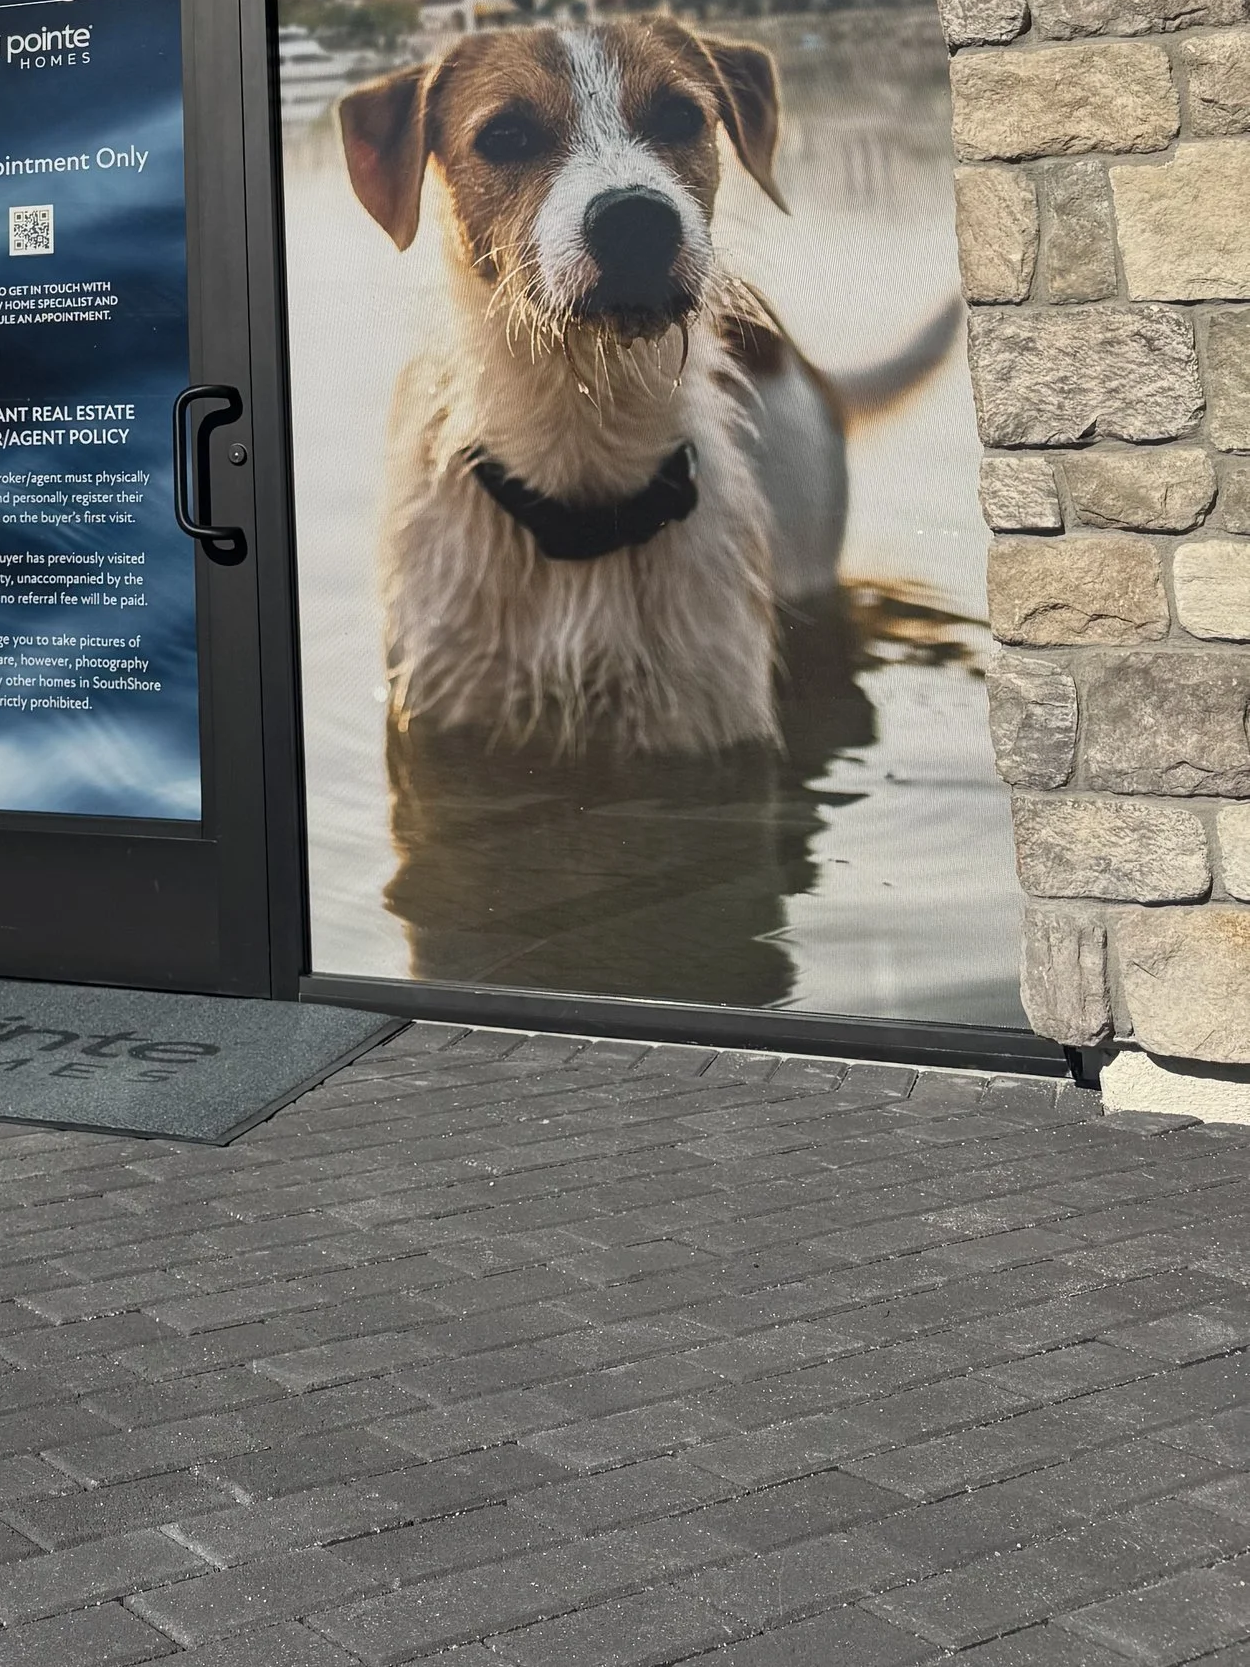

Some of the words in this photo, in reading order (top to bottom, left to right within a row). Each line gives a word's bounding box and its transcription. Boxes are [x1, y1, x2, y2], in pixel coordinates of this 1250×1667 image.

[7, 24, 92, 64] pointe
[20, 51, 91, 69] HOMES
[96, 145, 148, 172] Only
[9, 286, 29, 296] GET
[31, 285, 41, 295] IN
[43, 283, 80, 294] TOUCH
[82, 282, 110, 292] WITH
[5, 300, 35, 310] HOME
[38, 297, 93, 308] SPECIALIST
[95, 296, 118, 306] AND
[17, 314, 32, 323] AN
[34, 310, 111, 323] APPOINTMENT.
[33, 406, 72, 421] REAL
[77, 405, 135, 420] ESTATE
[70, 429, 129, 444] POLICY
[65, 474, 92, 482] must
[96, 470, 149, 486] physically
[13, 491, 68, 508] personally
[72, 492, 113, 506] register
[117, 491, 143, 502] their
[2, 515, 16, 523] on
[20, 511, 38, 523] the
[84, 511, 106, 523] first
[109, 512, 135, 523] visit.
[27, 551, 45, 563] has
[48, 552, 104, 567] previously
[107, 552, 144, 564] visited
[17, 572, 103, 587] unaccompanied
[107, 572, 121, 588] by
[124, 572, 143, 585] the
[1, 595, 15, 603] no
[18, 592, 57, 604] referral
[60, 592, 78, 604] fee
[81, 593, 99, 604] will
[103, 593, 117, 605] be
[121, 594, 147, 609] paid.
[13, 636, 33, 648] you
[36, 636, 49, 645] to
[52, 634, 76, 646] take
[80, 635, 125, 650] pictures
[128, 635, 141, 647] of
[21, 654, 72, 669] however,
[76, 655, 148, 672] photography
[6, 674, 36, 686] other
[39, 675, 76, 688] homes
[80, 676, 89, 688] in
[93, 676, 161, 691] SouthShore
[31, 696, 92, 711] prohibited.
